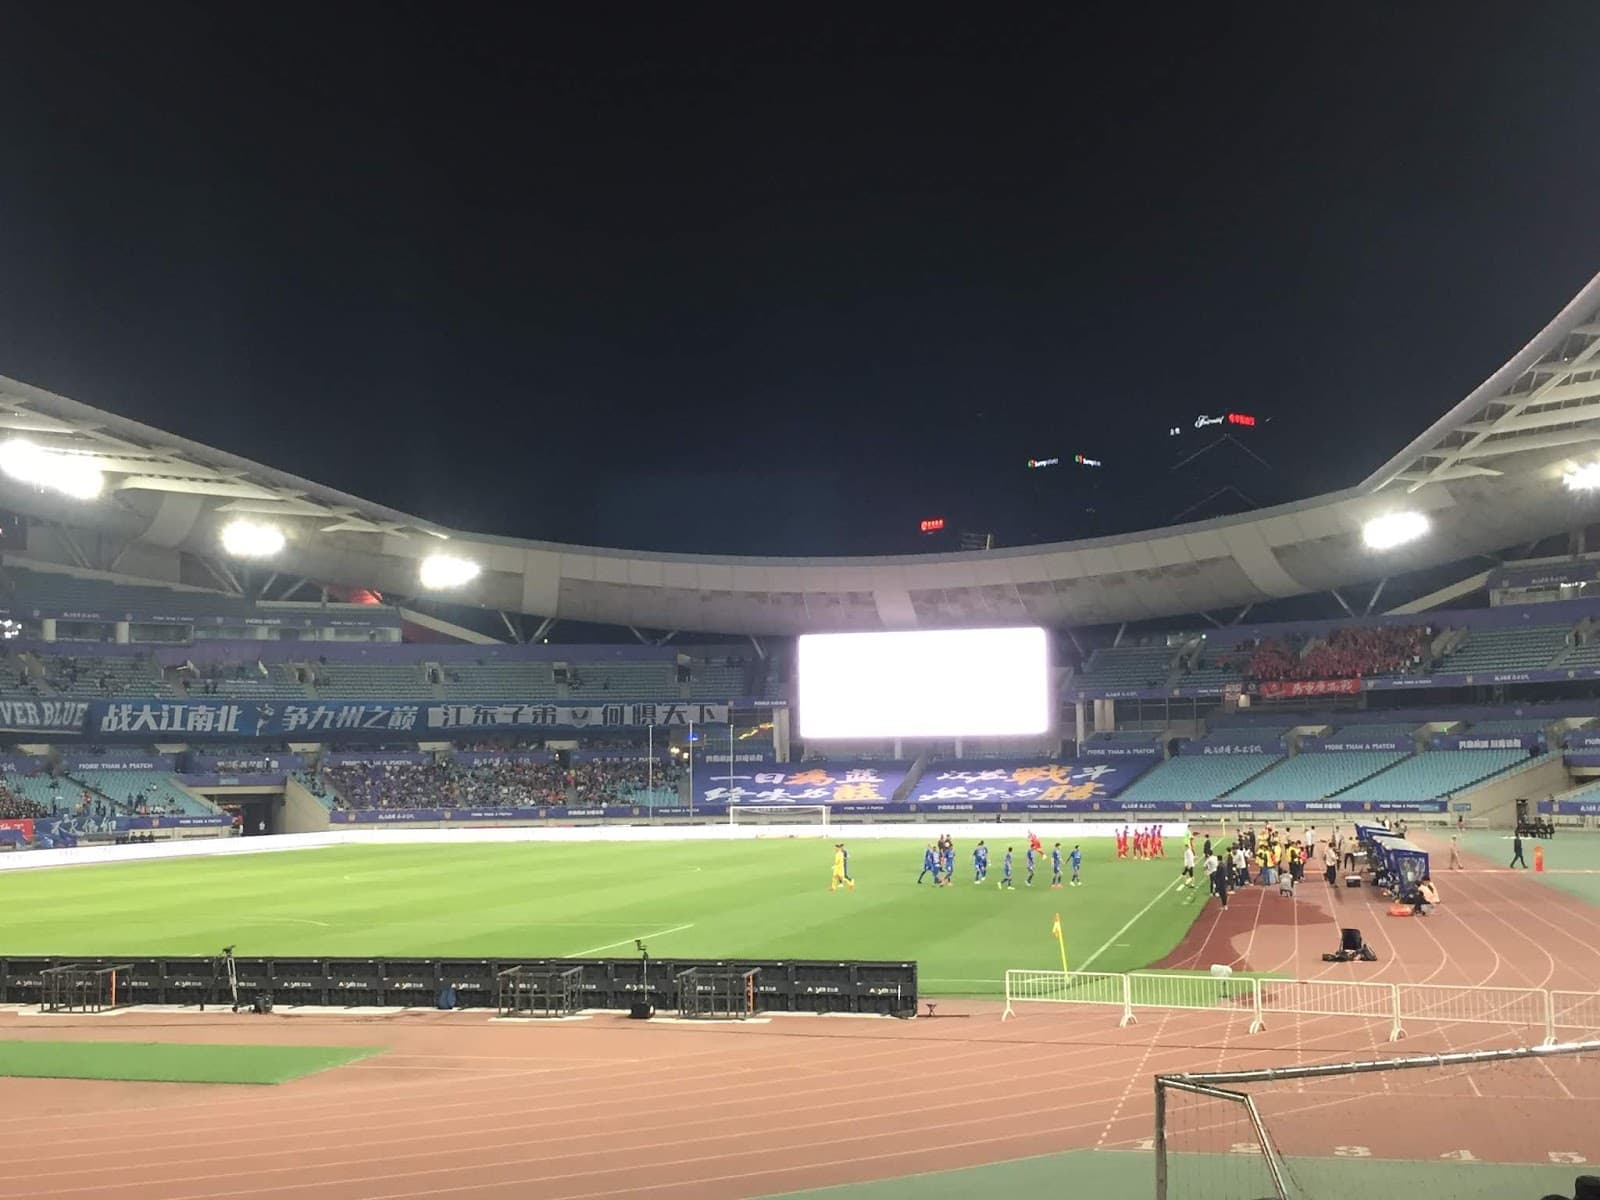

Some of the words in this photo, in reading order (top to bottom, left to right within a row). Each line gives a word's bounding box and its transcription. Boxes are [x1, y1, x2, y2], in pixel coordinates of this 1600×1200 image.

[43, 702, 88, 727] BLUE
[101, 703, 242, 733] 战大江南北
[282, 705, 419, 732] 争九州之巅
[441, 704, 557, 728] 江东子弟
[601, 703, 717, 727] 何惧天下
[1333, 1145, 1372, 1157] 3
[1440, 1149, 1482, 1161] 4
[1548, 1151, 1587, 1164] 5
